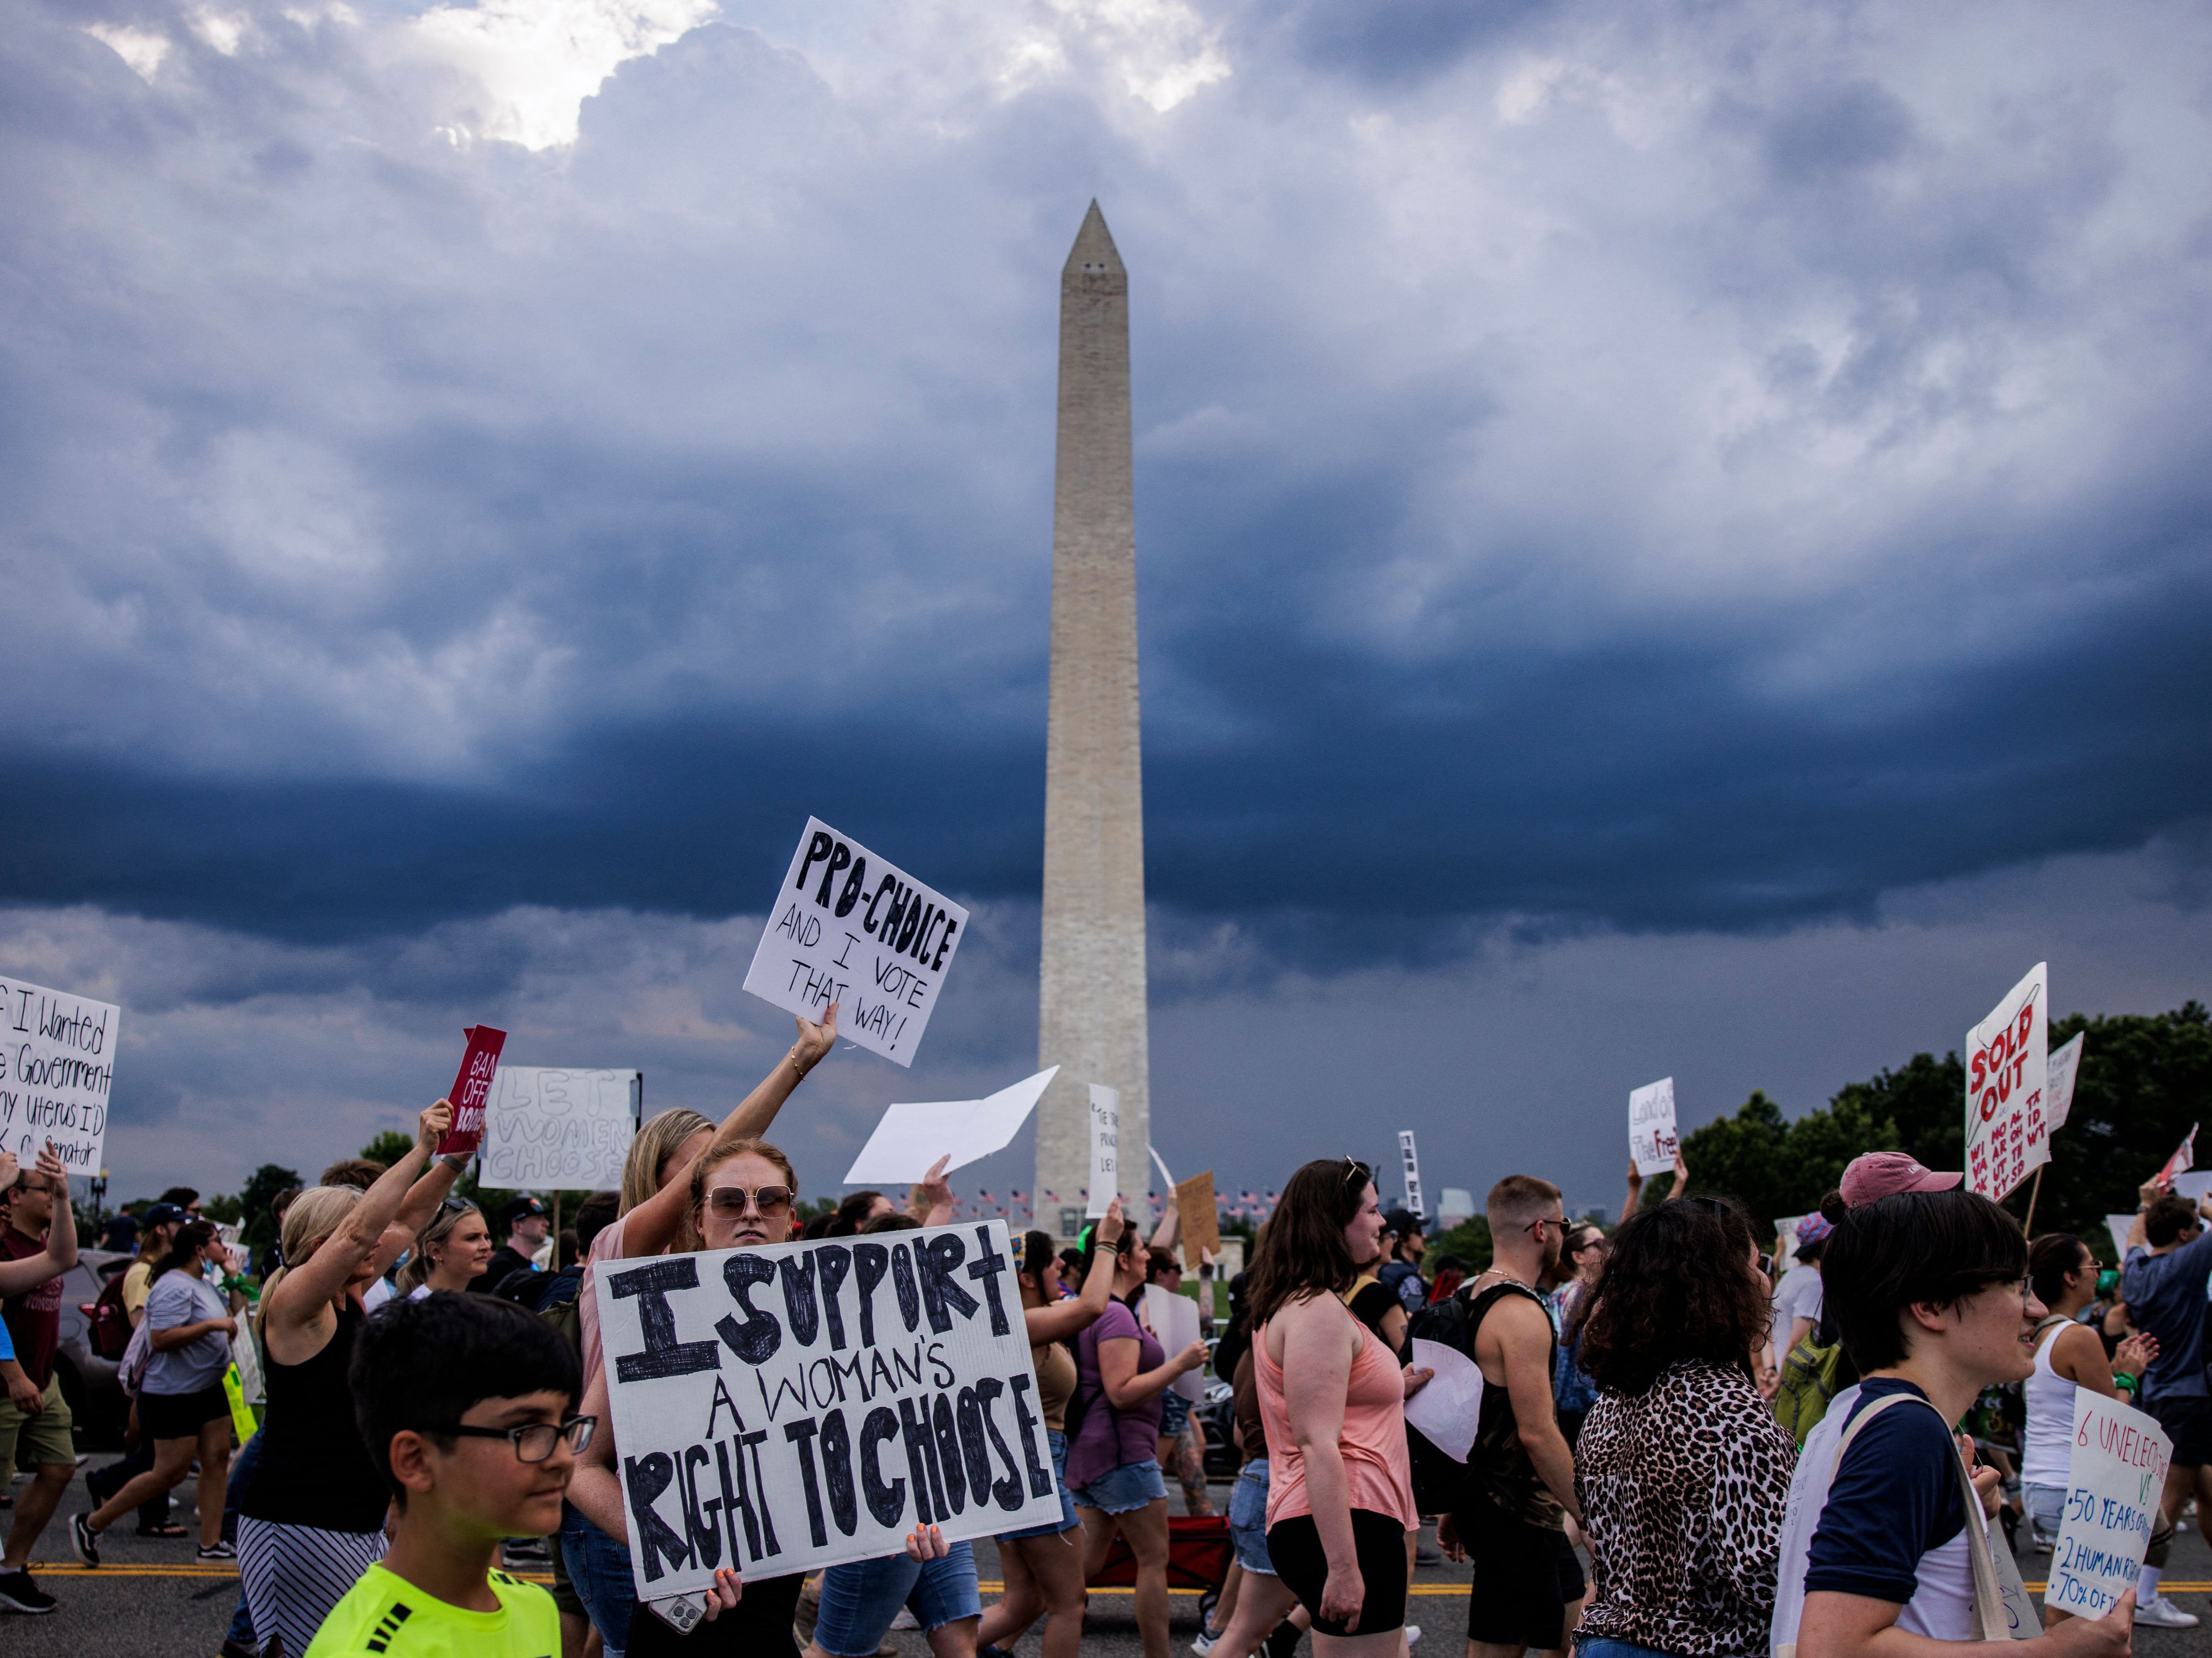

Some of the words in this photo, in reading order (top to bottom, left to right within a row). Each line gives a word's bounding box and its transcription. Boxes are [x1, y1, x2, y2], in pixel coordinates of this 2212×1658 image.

[796, 831, 957, 972] PRO-CHOICE
[775, 903, 821, 946] AND
[833, 932, 860, 969] I
[876, 956, 927, 1008] VOTE
[13, 989, 33, 1031] I
[40, 997, 107, 1054] Wanted
[789, 959, 849, 1008] THAT
[855, 997, 907, 1050] WAY!
[1970, 1004, 2032, 1094] SOLD
[498, 1066, 616, 1117] LET
[1980, 1050, 2028, 1122] OUT
[495, 1110, 636, 1153] WOMEN
[1971, 1141, 1984, 1162] WI
[2026, 1088, 2041, 1110] TX
[1973, 1157, 1988, 1181] VA
[1993, 1139, 2006, 1162] AR
[2010, 1124, 2022, 1143] OH
[2028, 1109, 2040, 1127] ID
[1994, 1157, 2006, 1182] UT
[2027, 1121, 2046, 1147] WY
[490, 1145, 623, 1183] CHOOSE
[1994, 1175, 2009, 1199] KY
[2011, 1160, 2024, 1183] SD
[607, 1256, 723, 1383] I
[705, 1374, 746, 1439] A
[756, 1335, 955, 1422] WOMAN'S
[2078, 1410, 2092, 1446] 6
[624, 1429, 781, 1583] RIGHT
[784, 1408, 858, 1548] TO
[860, 1372, 1053, 1529] CHOOSE
[2071, 1489, 2094, 1522] 50
[2101, 1498, 2136, 1531] YEARS
[2139, 1473, 2152, 1506] VS
[2061, 1536, 2073, 1567] 2
[2074, 1544, 2123, 1576] HUMAN
[2058, 1572, 2087, 1604] 70%
[2090, 1588, 2106, 1609] OF
